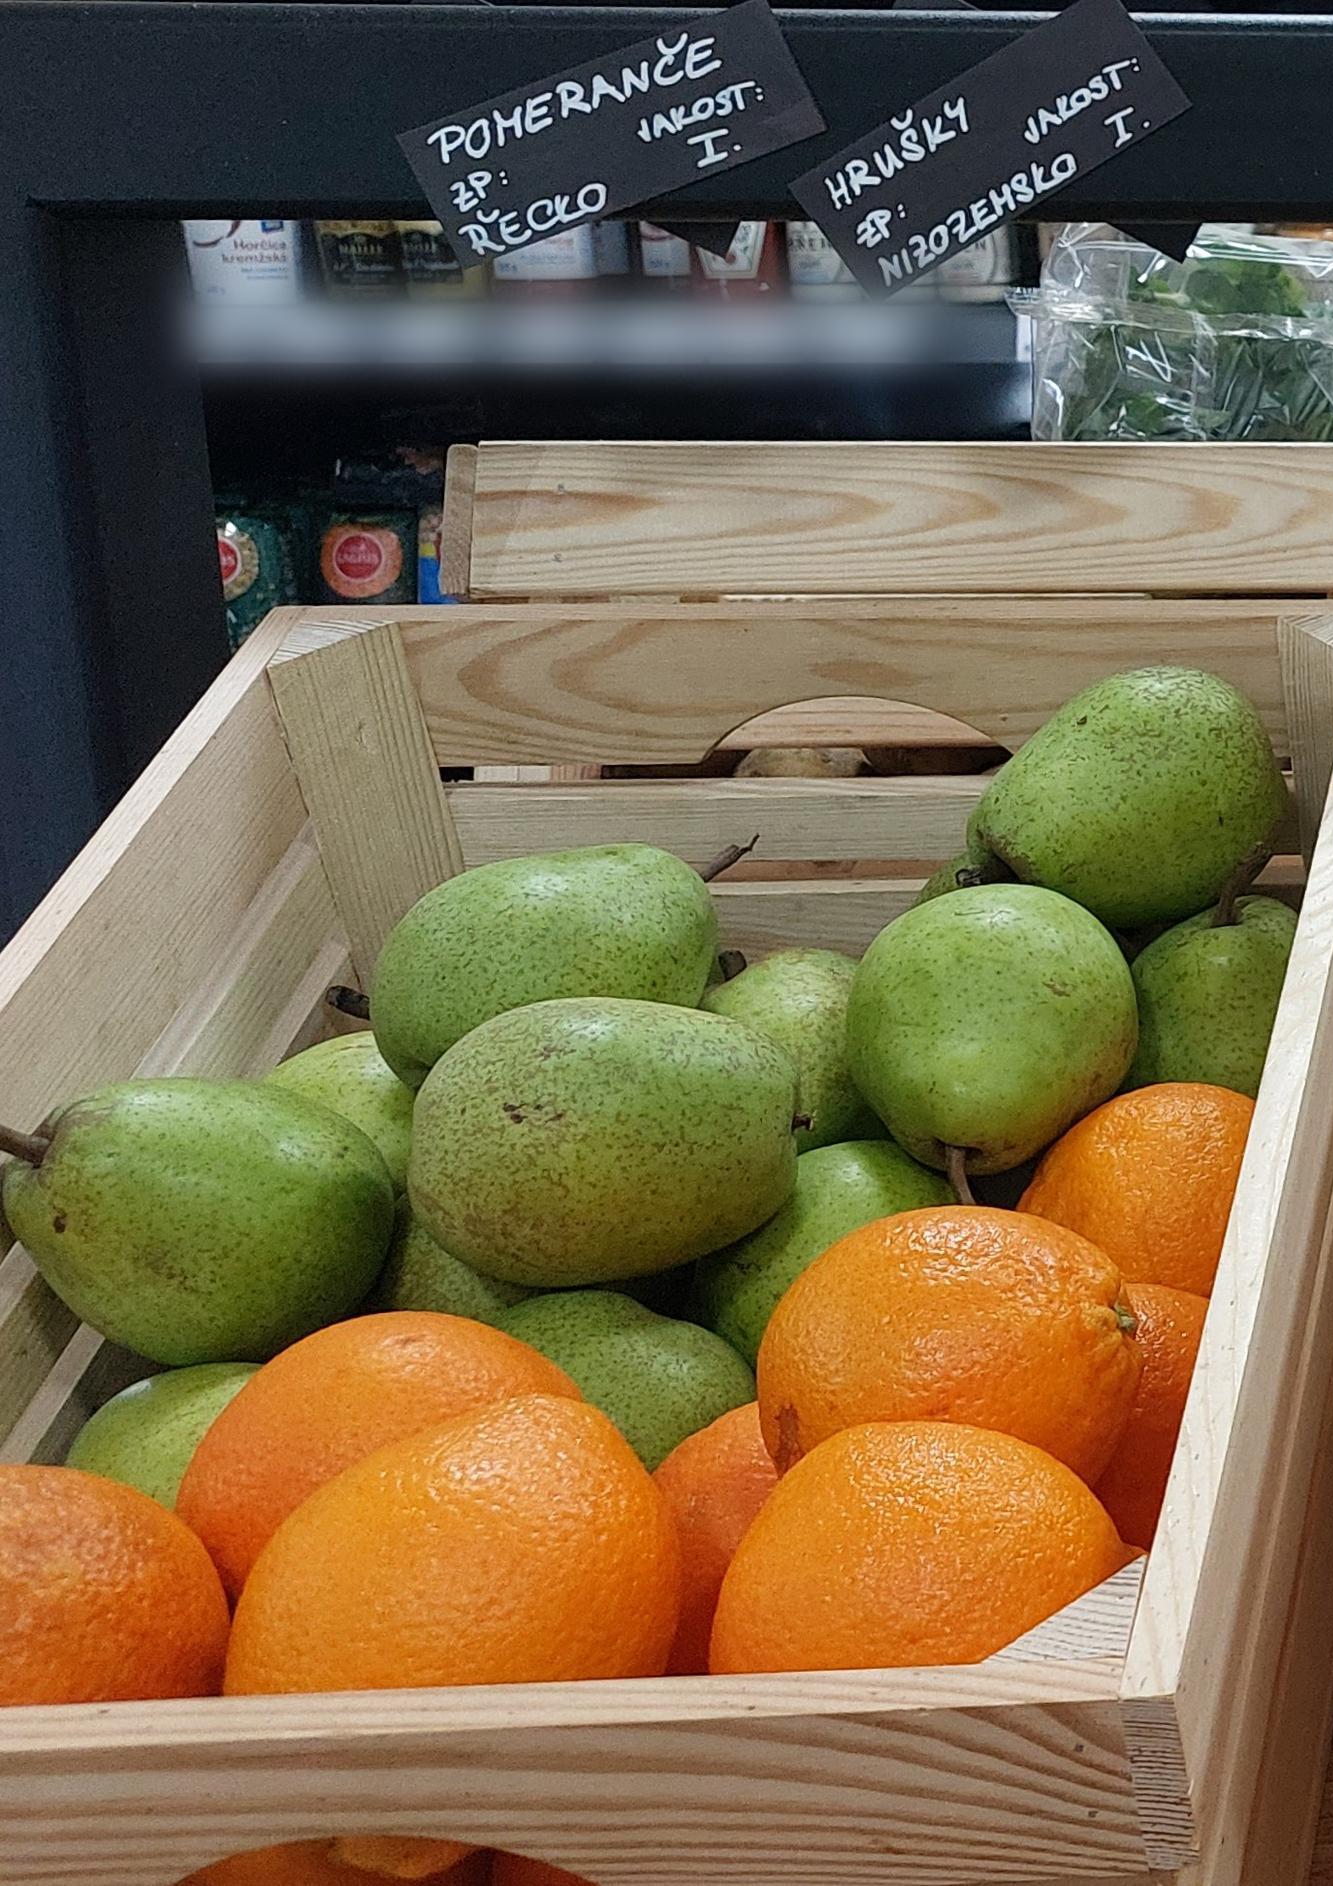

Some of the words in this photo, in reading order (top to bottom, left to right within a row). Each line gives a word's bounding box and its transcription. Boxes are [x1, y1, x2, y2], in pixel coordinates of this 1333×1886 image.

[427, 32, 723, 164] POMERANČE
[637, 80, 766, 143] JAKOST:
[1022, 57, 1141, 145] JAKOST:
[1103, 107, 1151, 148] I.
[686, 128, 743, 168] I.
[824, 97, 970, 210] HRUŠKY
[458, 182, 608, 256] ŘECKO
[877, 152, 1078, 288] NIZOZEMSKO
